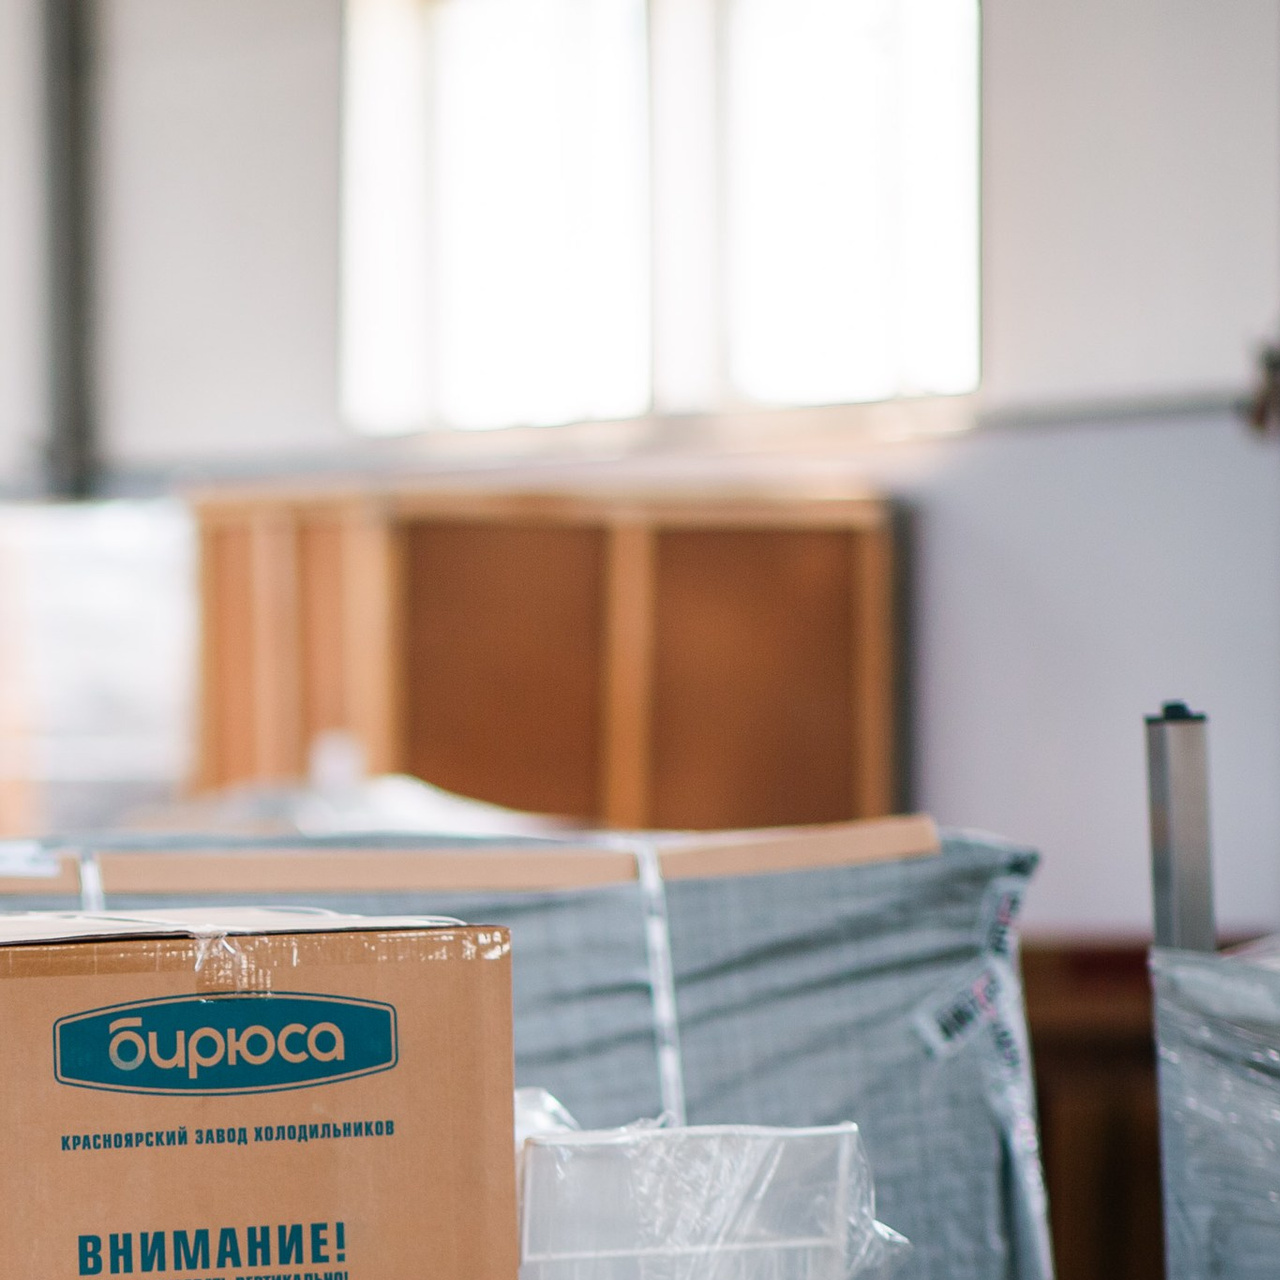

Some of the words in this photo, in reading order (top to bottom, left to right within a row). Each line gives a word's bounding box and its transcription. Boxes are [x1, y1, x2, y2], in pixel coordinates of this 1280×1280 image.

[108, 1016, 346, 1080] бирюса
[60, 1126, 188, 1151] КРАСНОЯРСКИЙ
[195, 1127, 248, 1146] ЗАВОД
[254, 1119, 395, 1143] ХОЛОДИЛЬНИКОВ
[77, 1221, 347, 1277] ВНИМАНИЕ!
